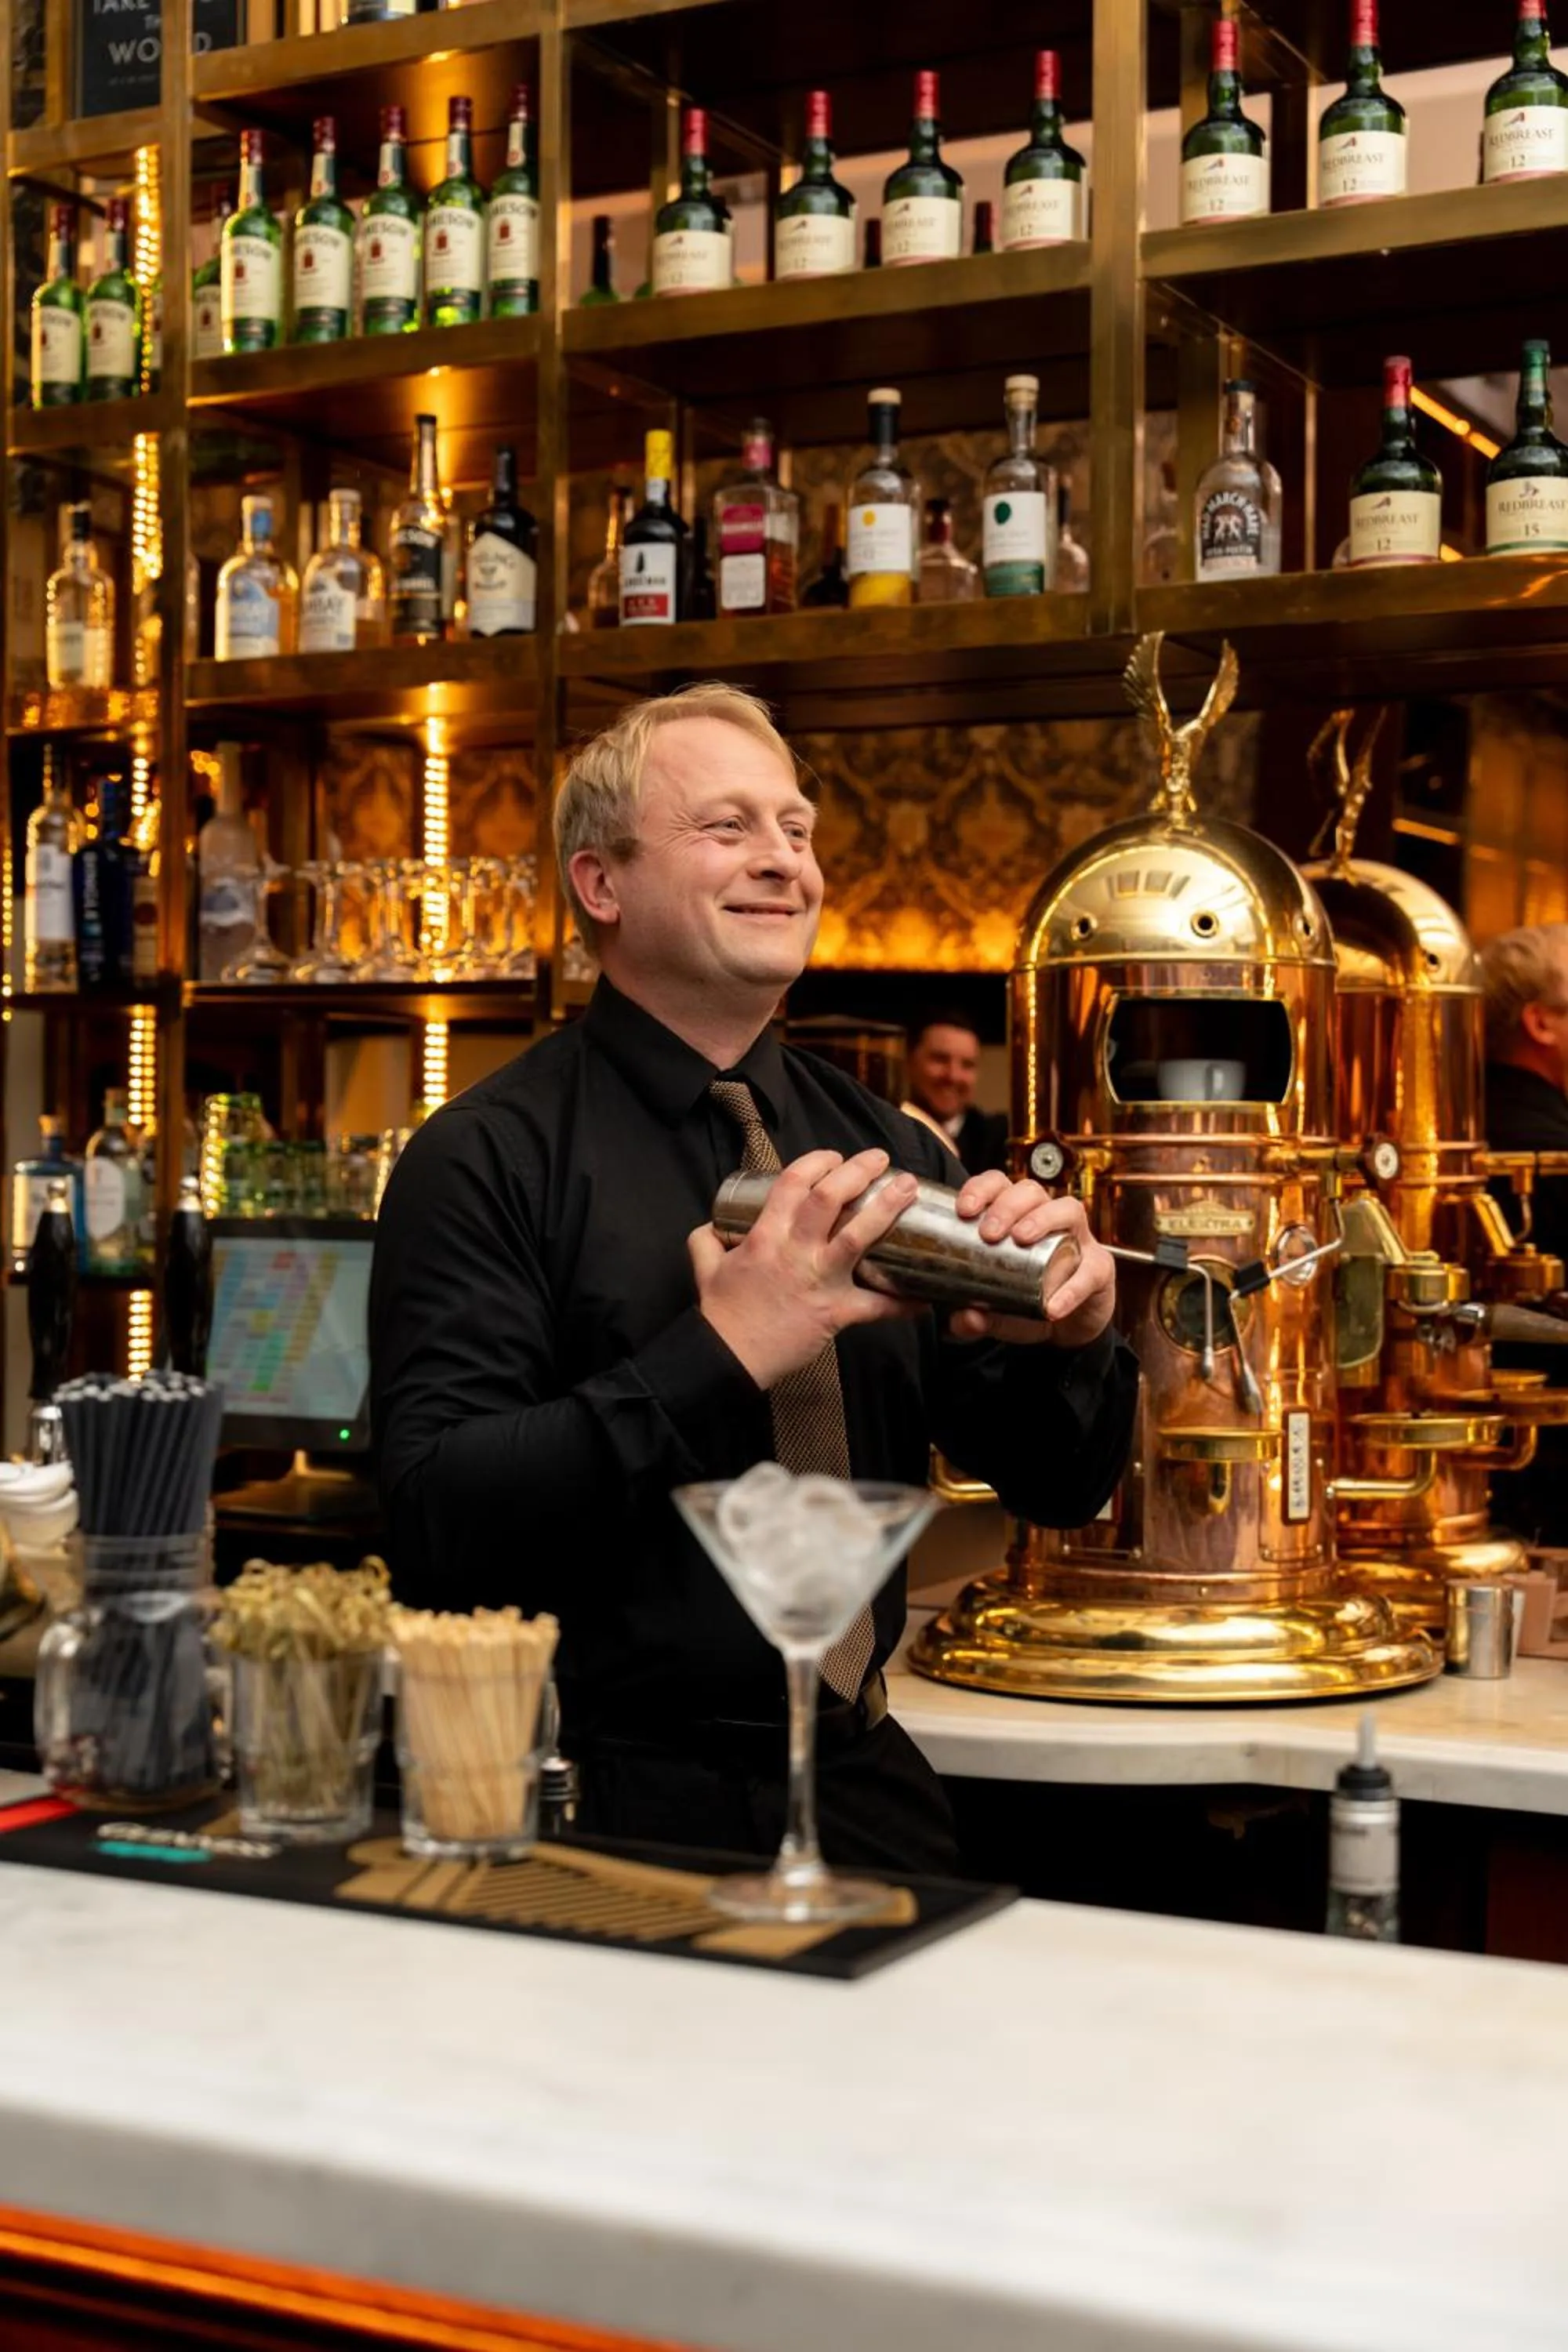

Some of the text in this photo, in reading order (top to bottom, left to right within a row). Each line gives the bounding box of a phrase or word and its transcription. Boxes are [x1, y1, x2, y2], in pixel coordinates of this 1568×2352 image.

[108, 31, 212, 65] WOD
[1511, 154, 1526, 169] 12
[1342, 178, 1357, 192] 12
[1209, 198, 1225, 212] 12
[1523, 523, 1540, 538] 15
[1376, 538, 1392, 552] 12
